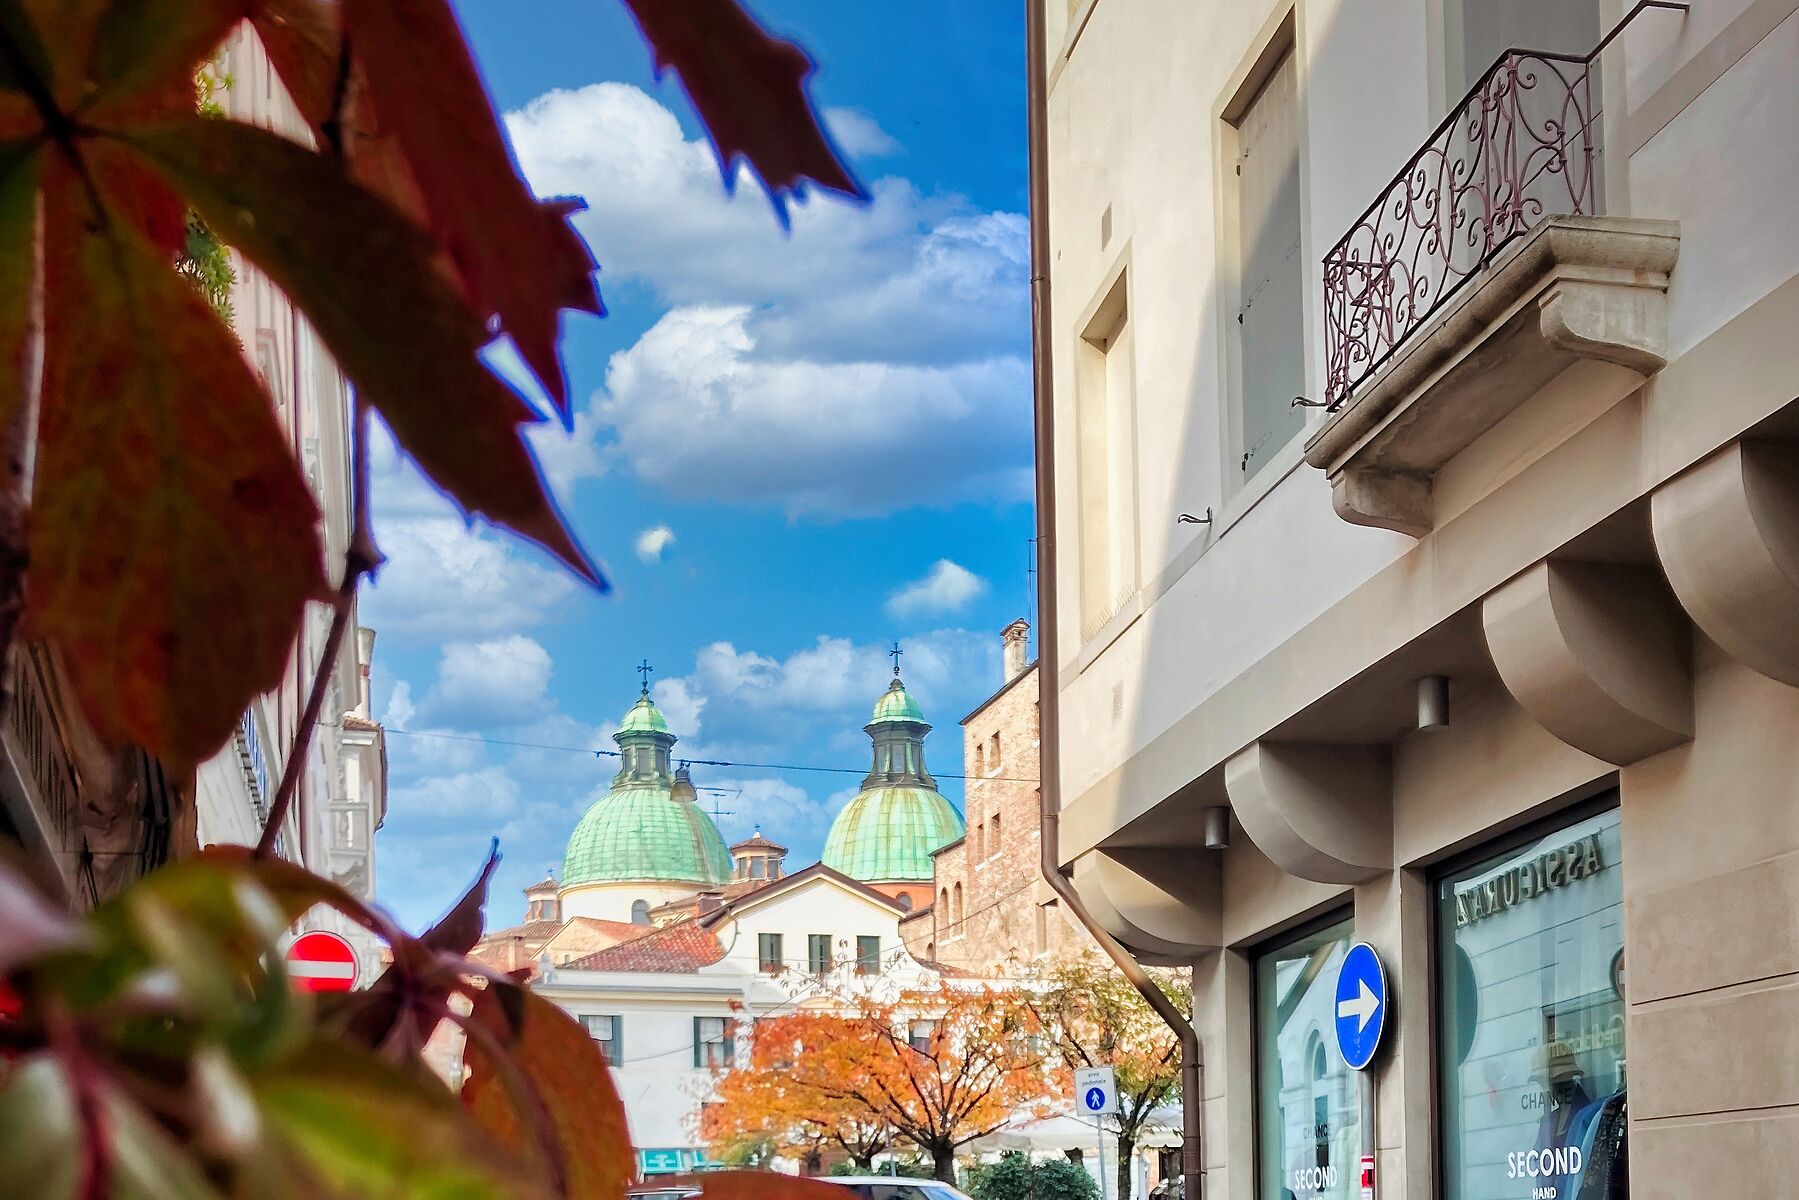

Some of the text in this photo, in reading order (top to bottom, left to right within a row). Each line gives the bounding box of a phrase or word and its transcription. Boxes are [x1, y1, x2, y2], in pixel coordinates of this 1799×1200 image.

[1521, 1088, 1572, 1110] CHANCE
[1507, 1146, 1582, 1179] SECOND
[1295, 1165, 1338, 1190] SECOND
[1532, 1186, 1557, 1200] HAND
